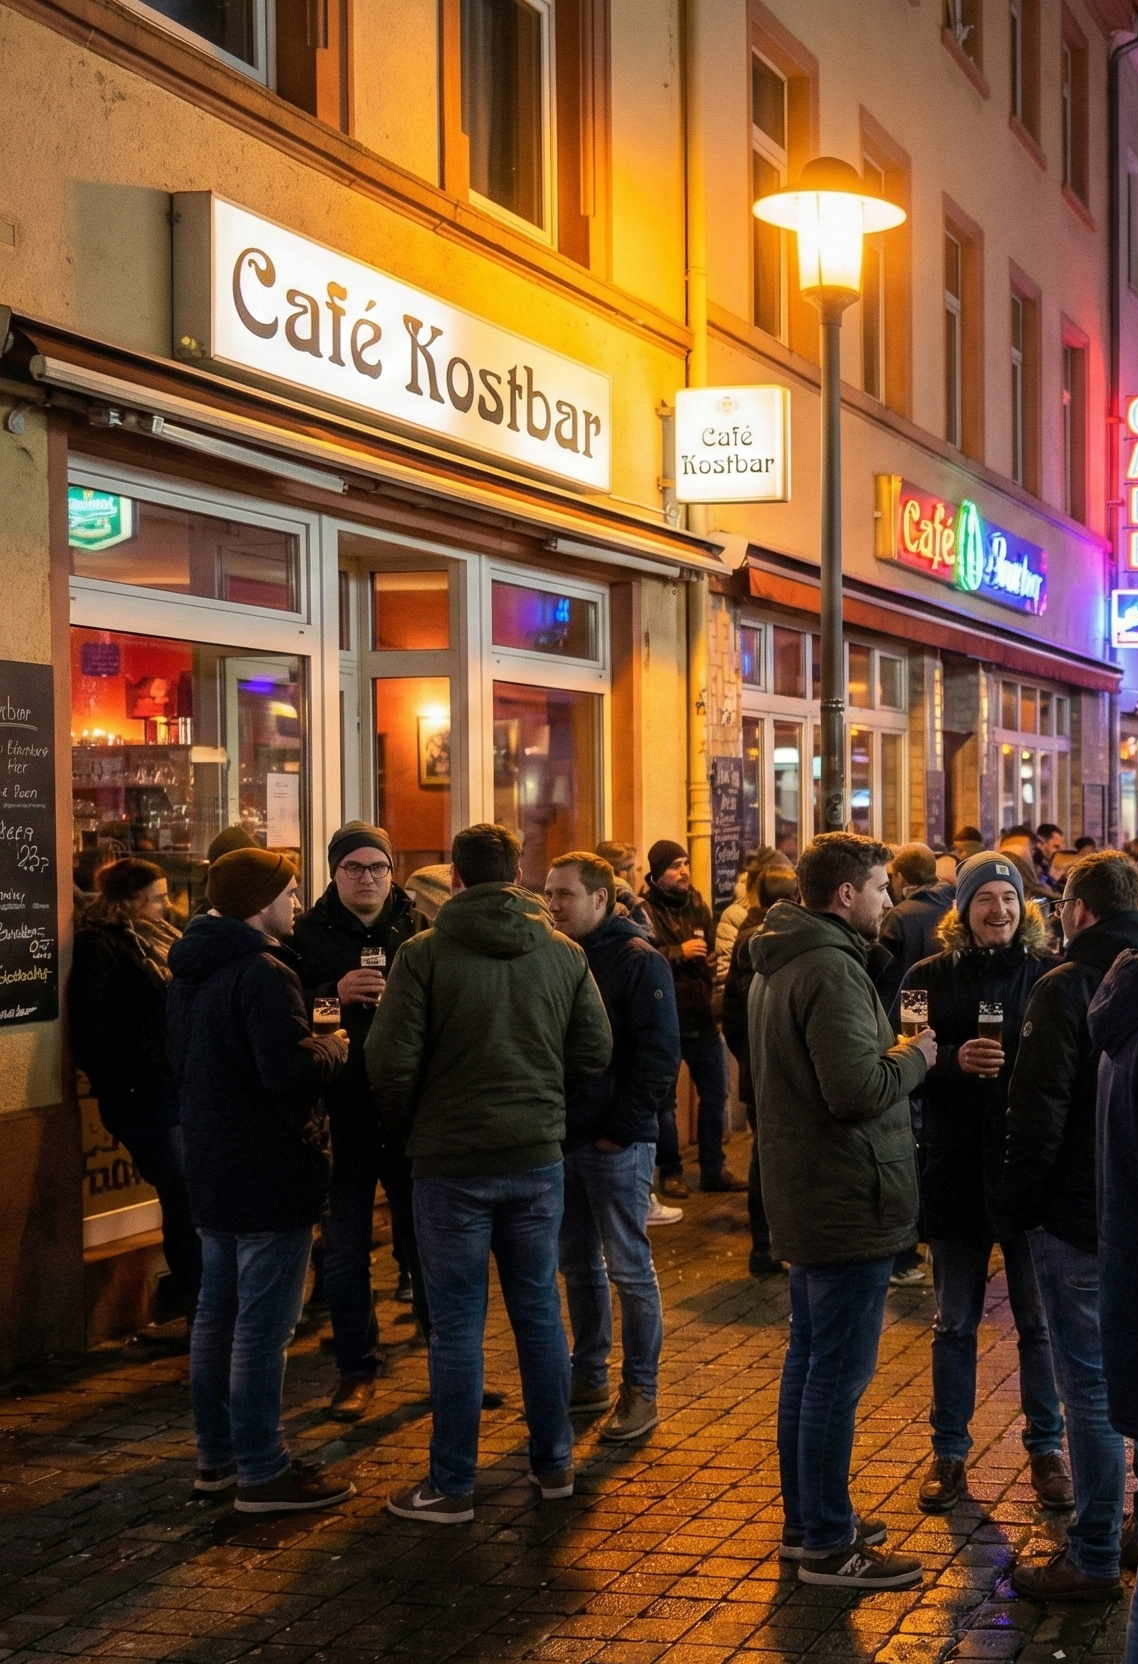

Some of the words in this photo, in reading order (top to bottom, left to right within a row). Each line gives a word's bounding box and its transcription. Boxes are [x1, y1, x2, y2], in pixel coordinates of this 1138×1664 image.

[232, 247, 382, 379] Café
[403, 314, 601, 459] Kostbar
[701, 425, 753, 447] Café
[681, 453, 775, 475] Kostbar
[903, 499, 956, 570] Café
